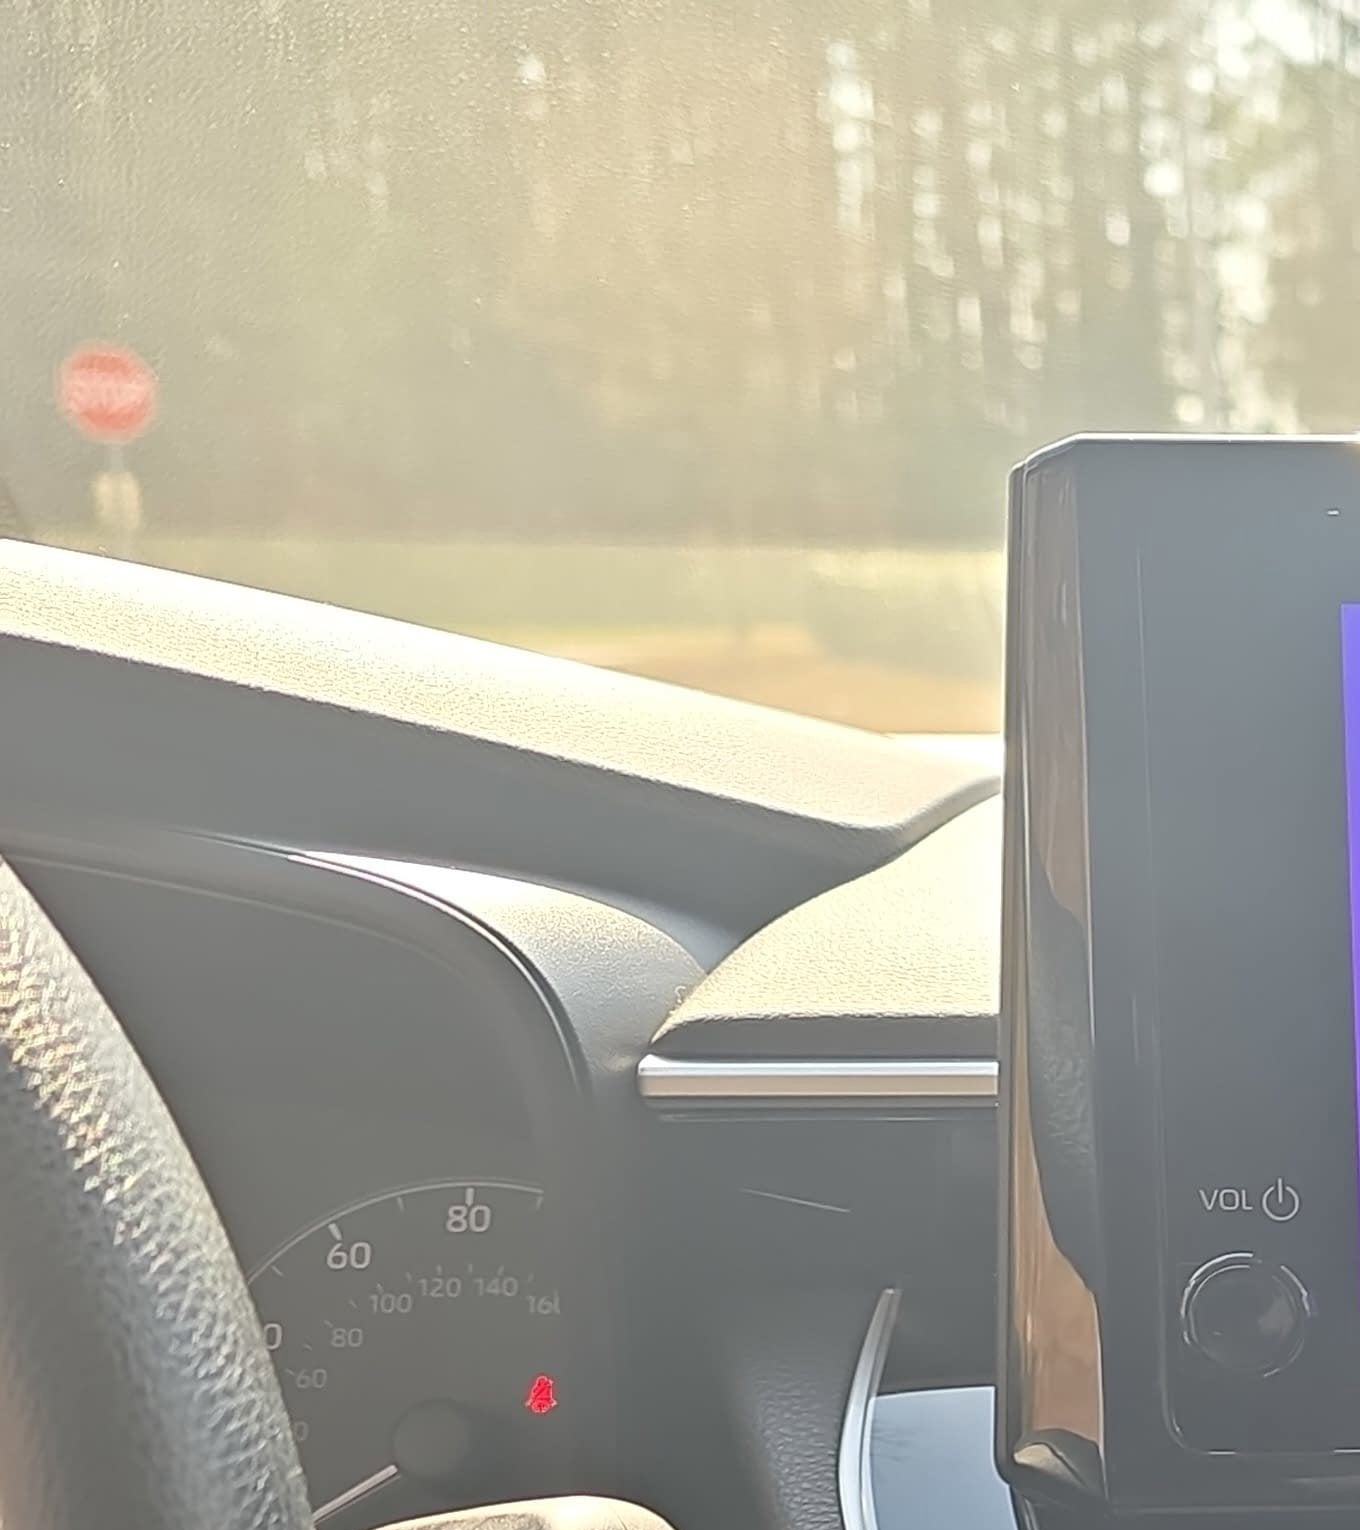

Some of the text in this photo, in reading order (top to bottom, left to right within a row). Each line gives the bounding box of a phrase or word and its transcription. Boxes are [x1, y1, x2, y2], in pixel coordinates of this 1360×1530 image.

[1198, 1188, 1254, 1211] VOL
[446, 1204, 492, 1234] 80
[326, 1241, 372, 1270] 60
[418, 1276, 463, 1299] 120
[473, 1276, 519, 1298] 140
[368, 1292, 413, 1315] 100
[330, 1326, 364, 1349] 80
[295, 1367, 328, 1390] 60
